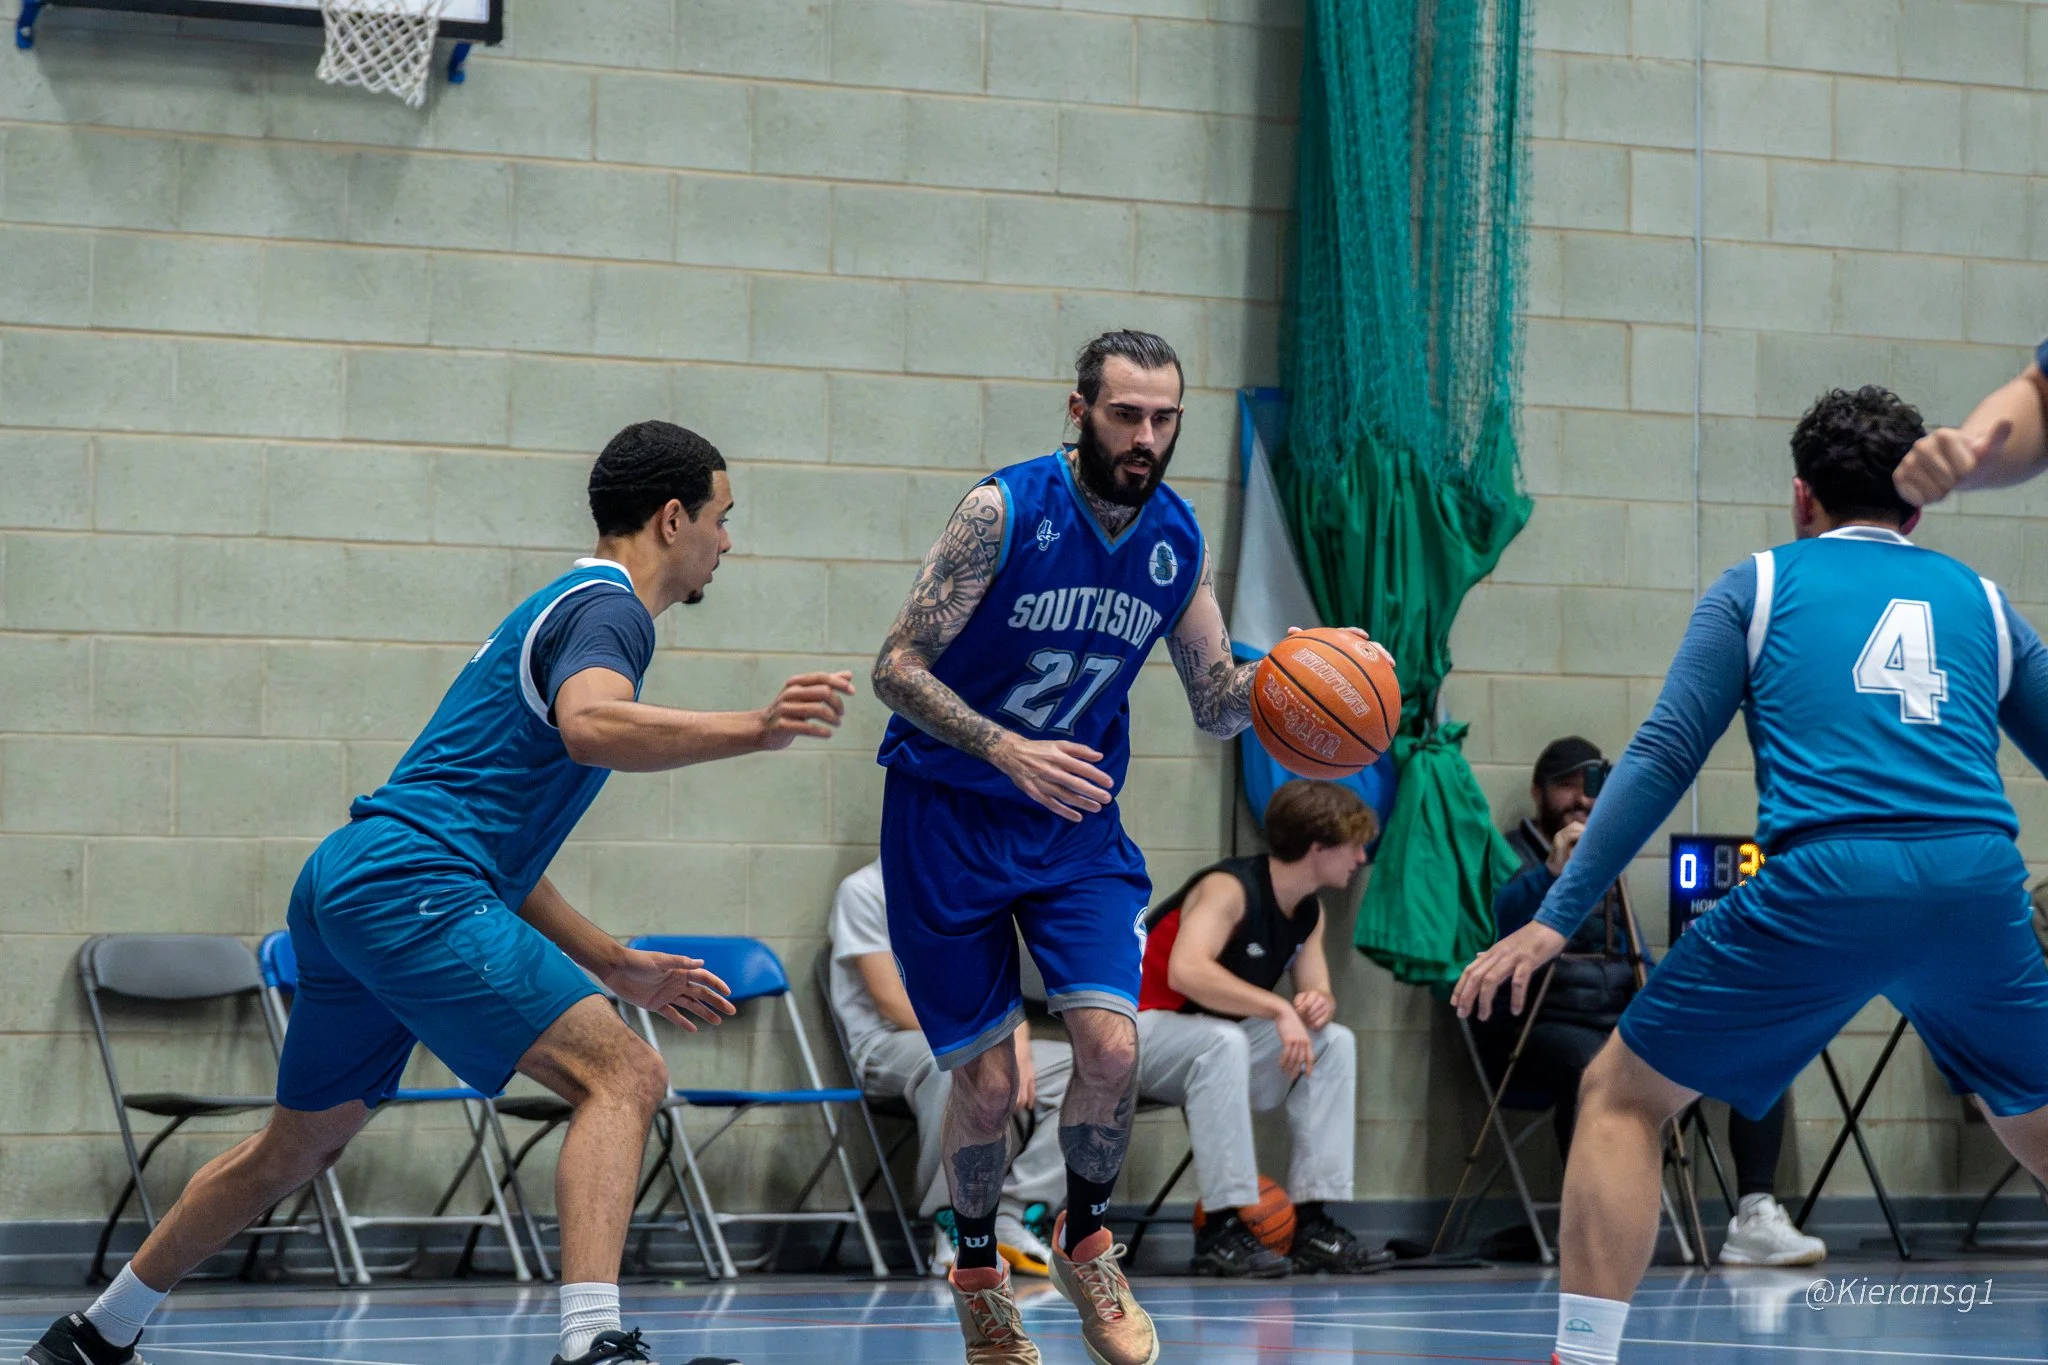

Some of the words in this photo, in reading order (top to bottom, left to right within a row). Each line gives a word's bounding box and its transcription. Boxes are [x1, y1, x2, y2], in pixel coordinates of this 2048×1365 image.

[996, 646, 1126, 736] 27
[1851, 597, 1949, 726] 4
[1680, 853, 1697, 889] 0
